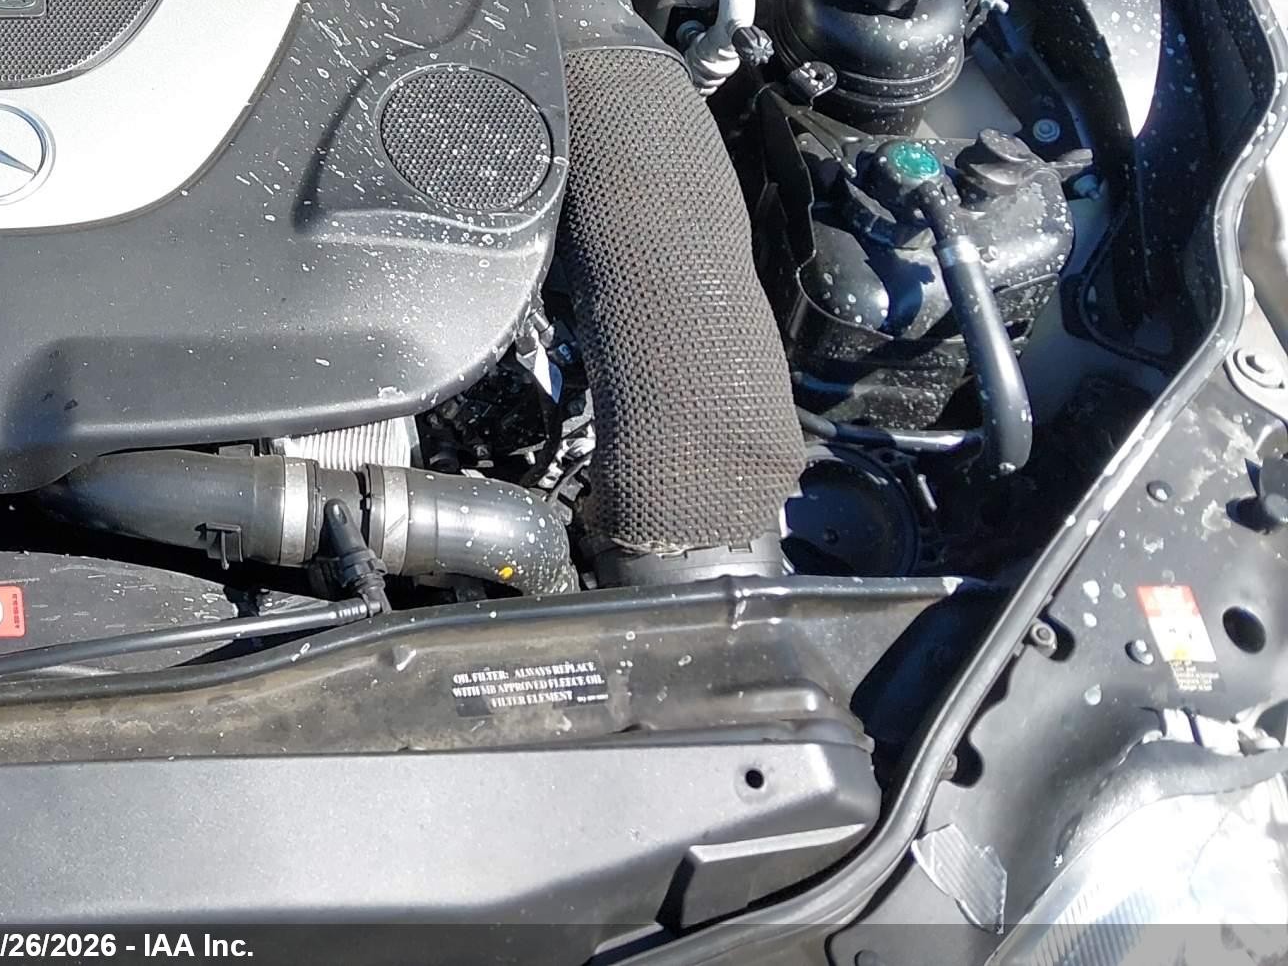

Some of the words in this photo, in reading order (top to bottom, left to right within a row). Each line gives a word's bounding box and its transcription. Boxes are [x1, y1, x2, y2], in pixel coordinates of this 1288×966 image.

[453, 673, 472, 685] OIL
[515, 666, 552, 679] ALWAYS
[552, 661, 596, 675] REPLACE
[452, 686, 480, 698] WITH
[497, 680, 548, 694] APPROVED
[586, 674, 605, 685] OIL
[491, 695, 526, 708] FILTER
[526, 690, 573, 705] ELEMENT
